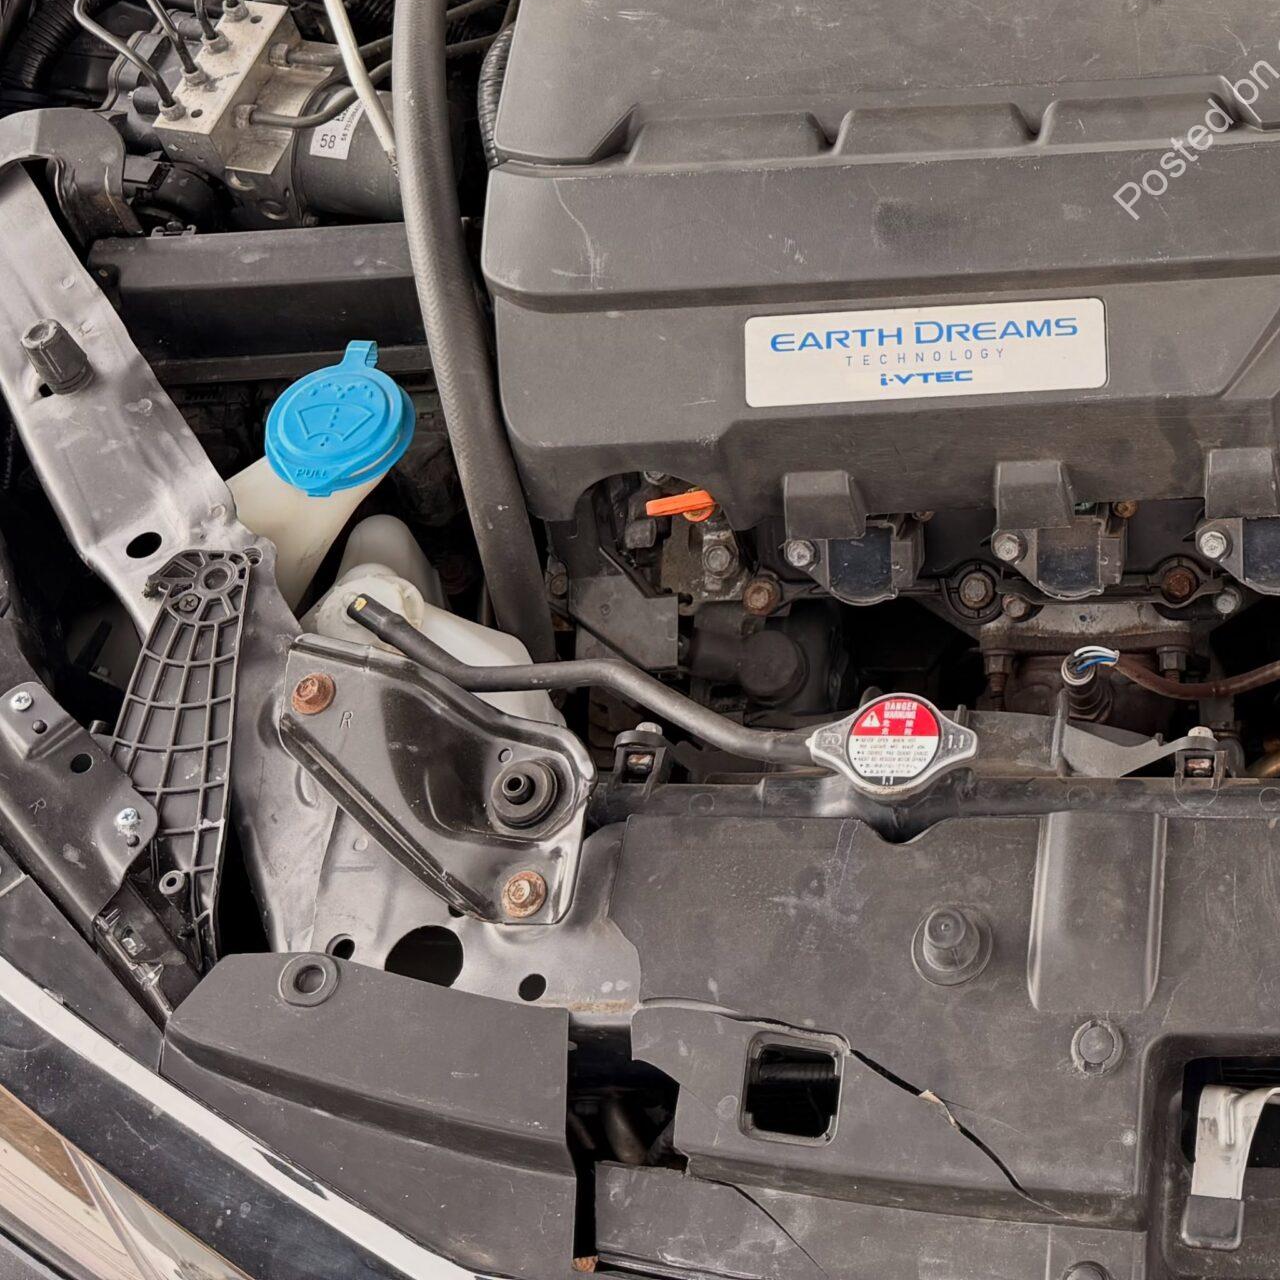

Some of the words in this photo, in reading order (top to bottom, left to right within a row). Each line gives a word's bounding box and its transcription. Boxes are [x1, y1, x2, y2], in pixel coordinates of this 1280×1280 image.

[320, 133, 336, 149] 58
[770, 327, 902, 352] EARTH
[914, 317, 1078, 344] DREAMS
[845, 348, 1004, 367] TECHNOLOGY
[880, 370, 973, 386] i-VTEC
[884, 702, 918, 710] DANGER
[340, 711, 353, 729] R
[948, 734, 964, 749] 1.1
[882, 776, 894, 785] 1.1
